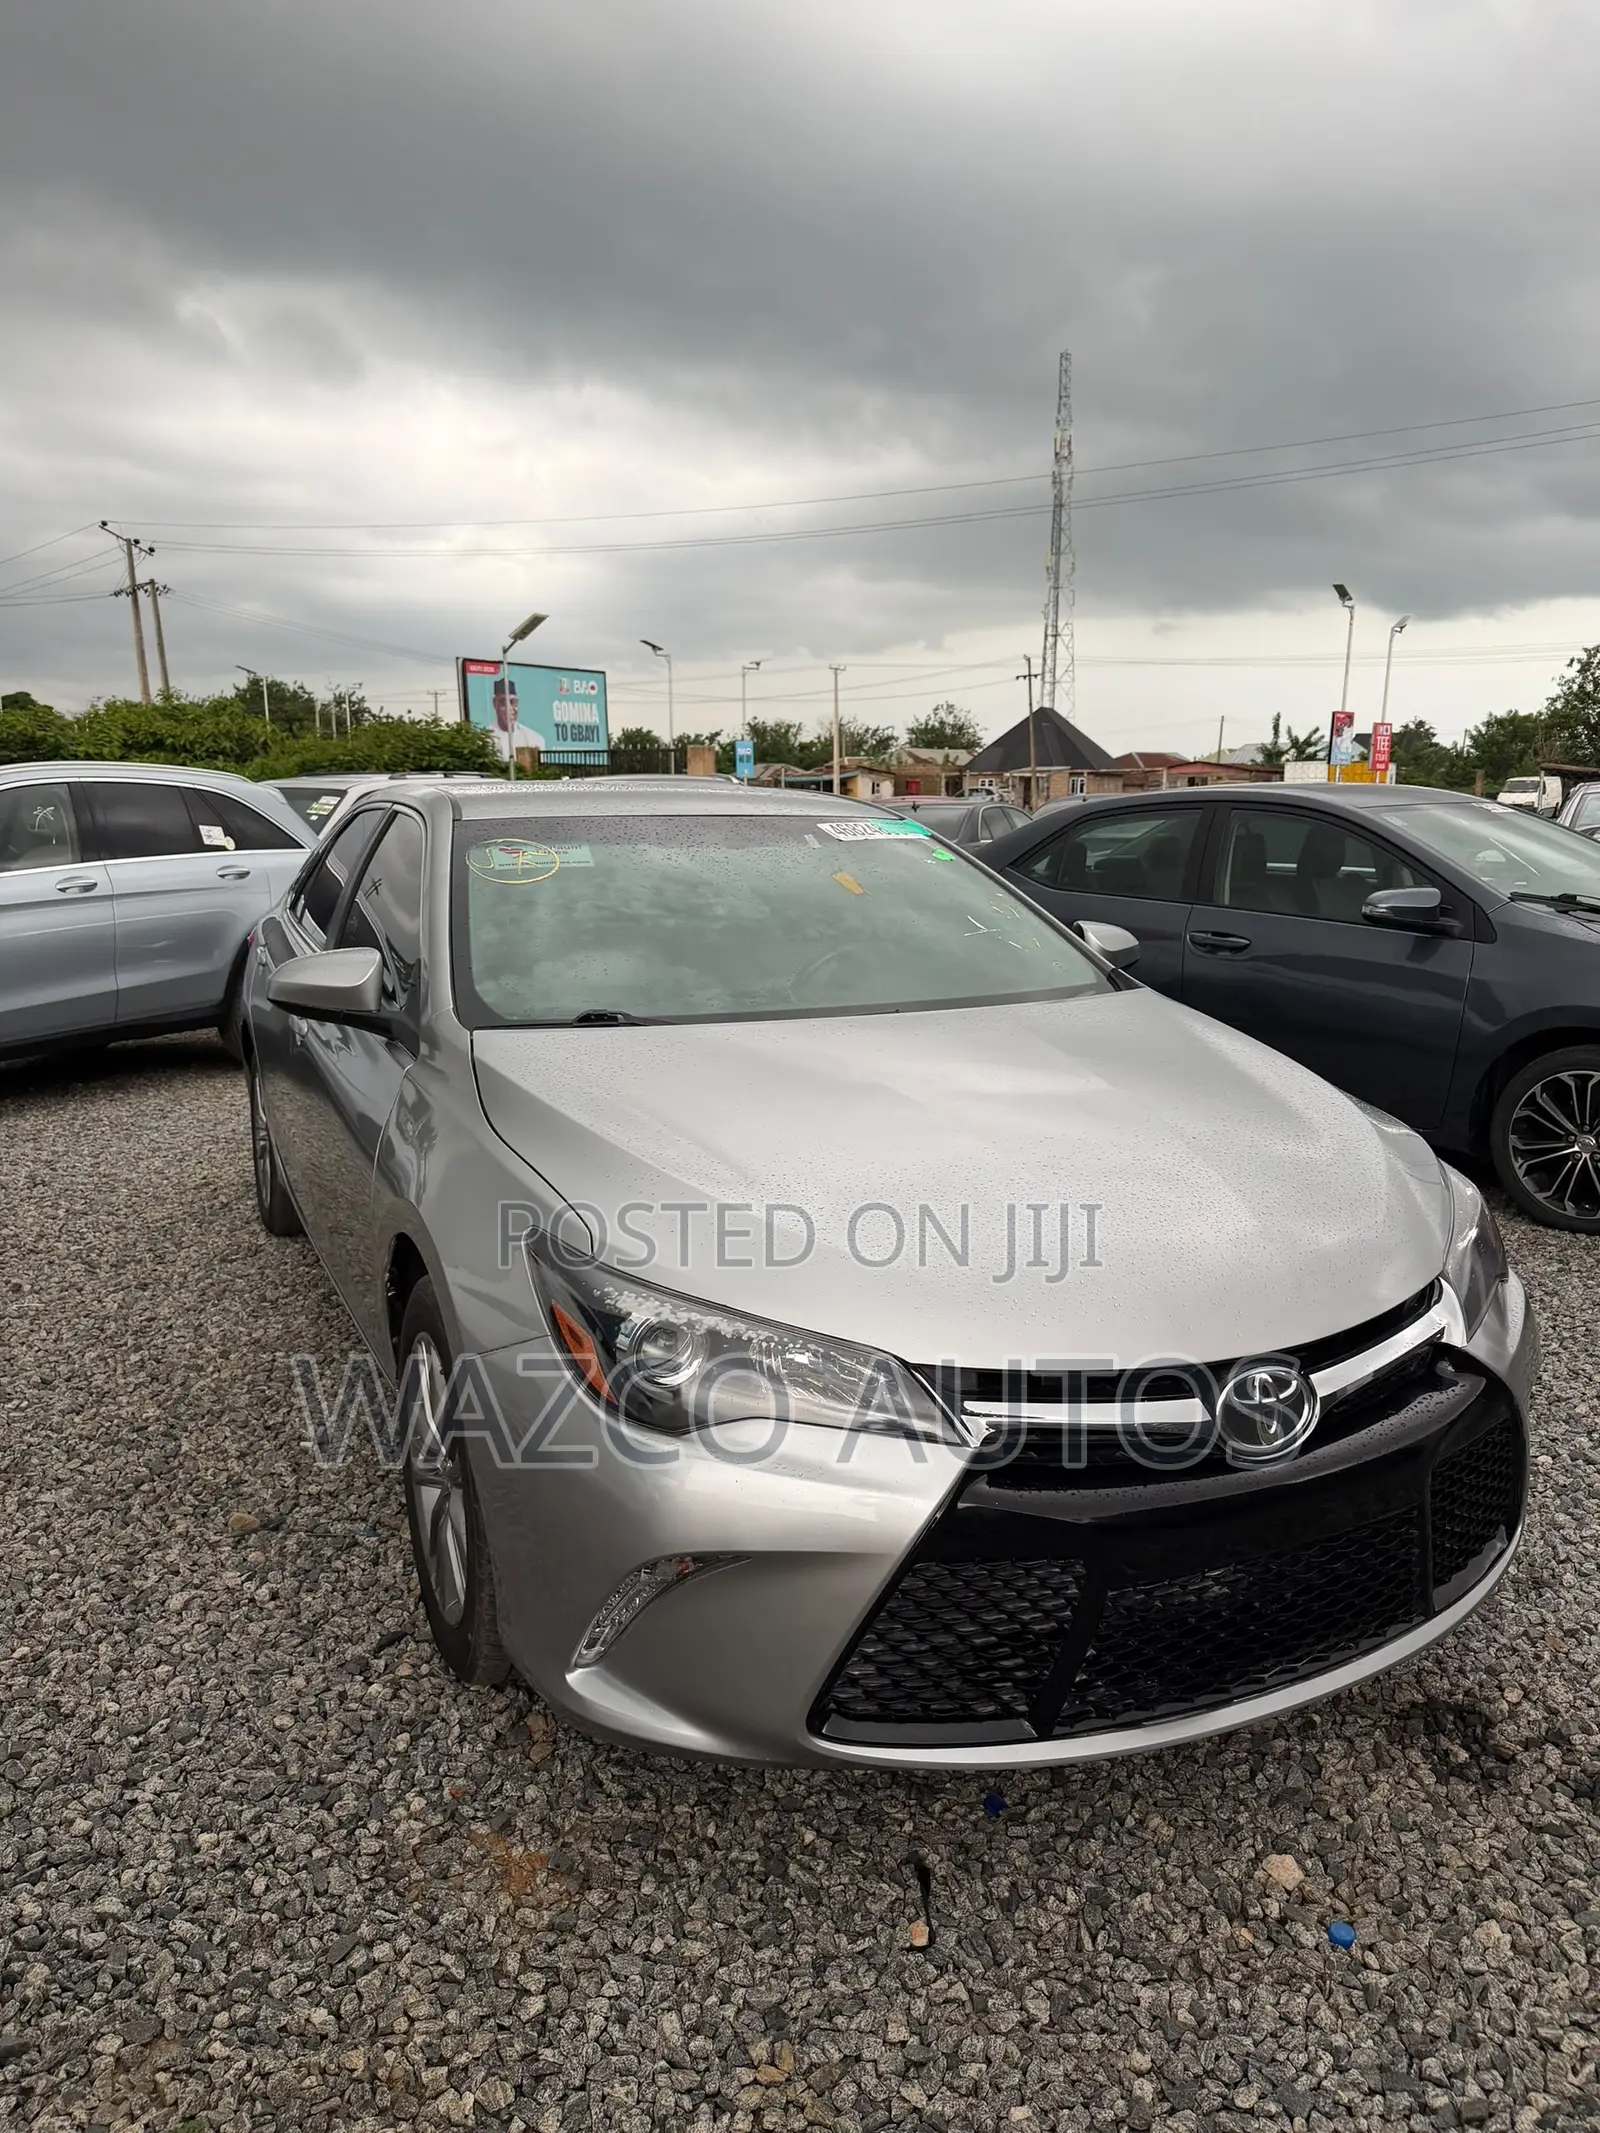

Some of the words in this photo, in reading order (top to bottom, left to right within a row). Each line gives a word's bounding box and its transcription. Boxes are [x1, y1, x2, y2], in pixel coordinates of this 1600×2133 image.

[553, 700, 599, 724] GOMINA
[555, 723, 568, 742] TO
[570, 724, 600, 743] GBAYI
